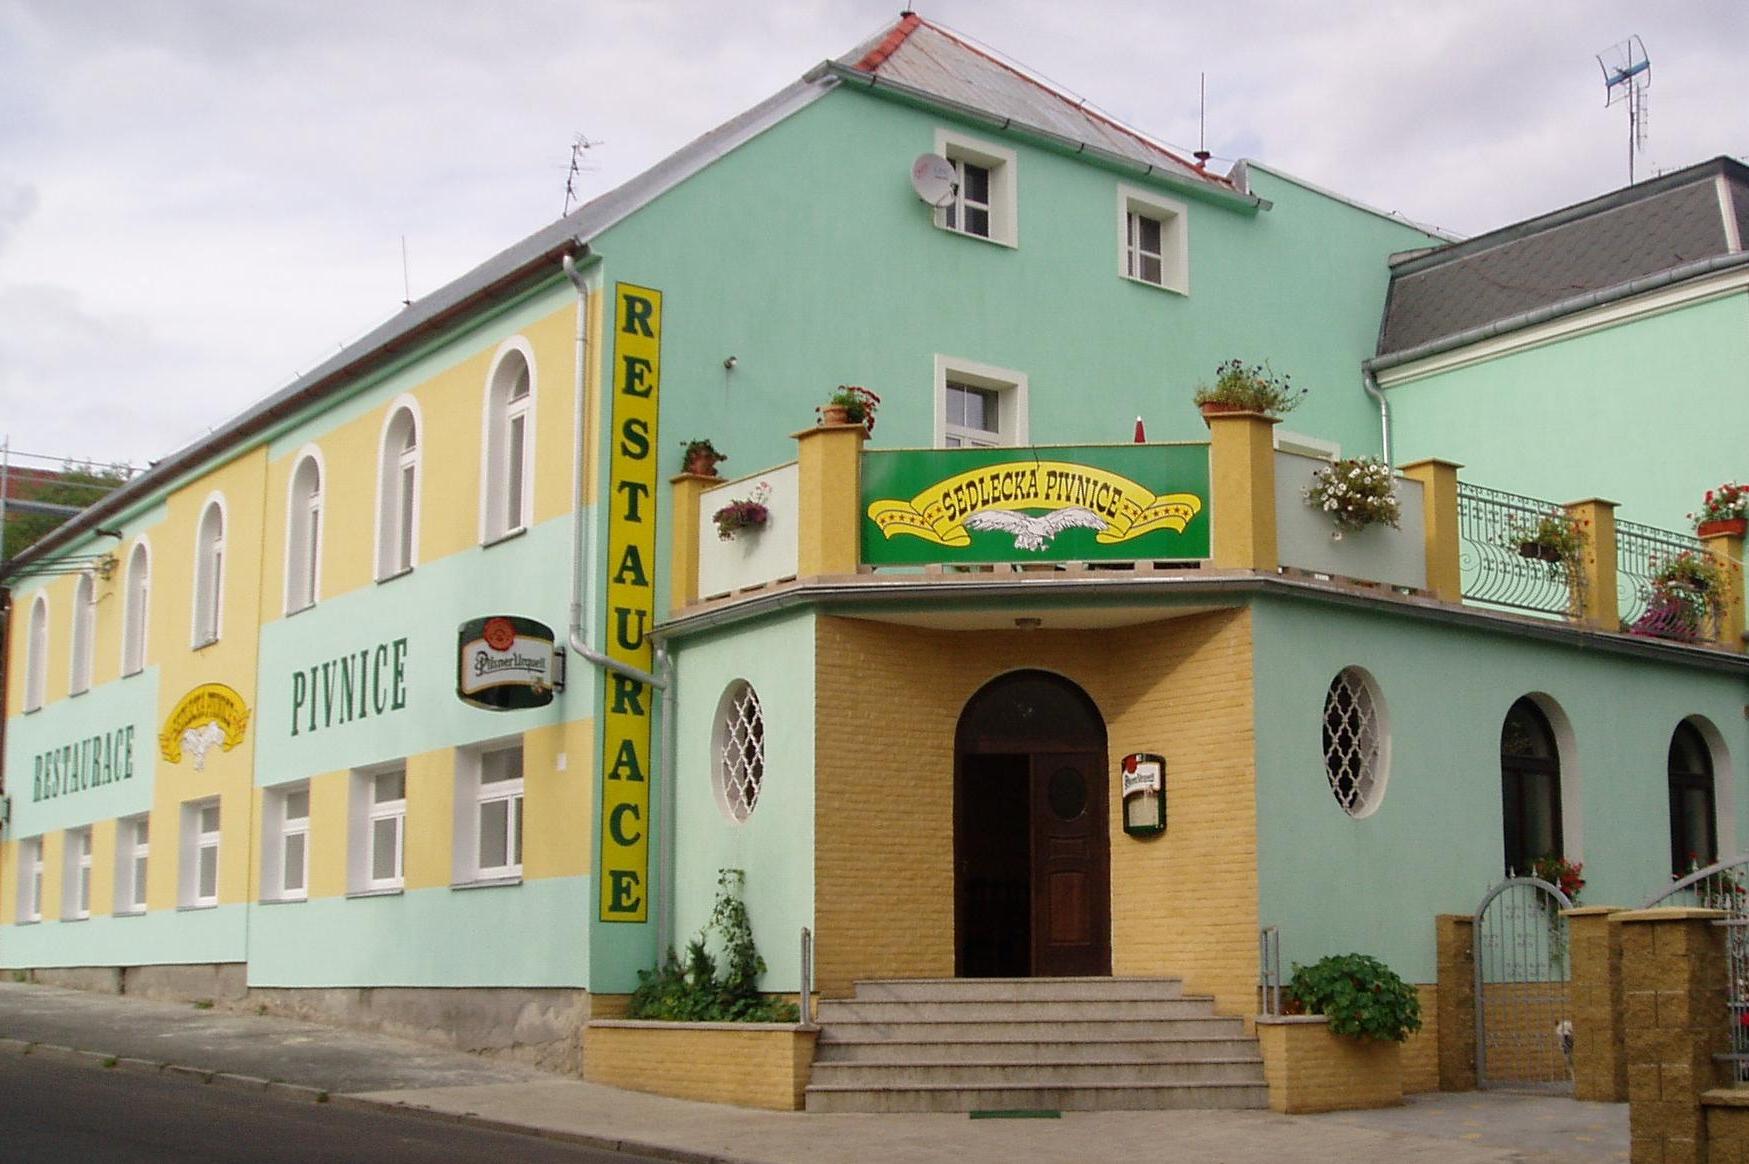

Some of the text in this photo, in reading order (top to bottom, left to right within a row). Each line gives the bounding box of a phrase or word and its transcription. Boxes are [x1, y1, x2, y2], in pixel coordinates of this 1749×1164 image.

[1045, 471, 1122, 519] PIVNICE
[608, 294, 655, 914] RESTAURACE
[291, 638, 408, 736] PIVNICE
[476, 651, 513, 675] Pilsner
[34, 725, 135, 801] RESTAURACE
